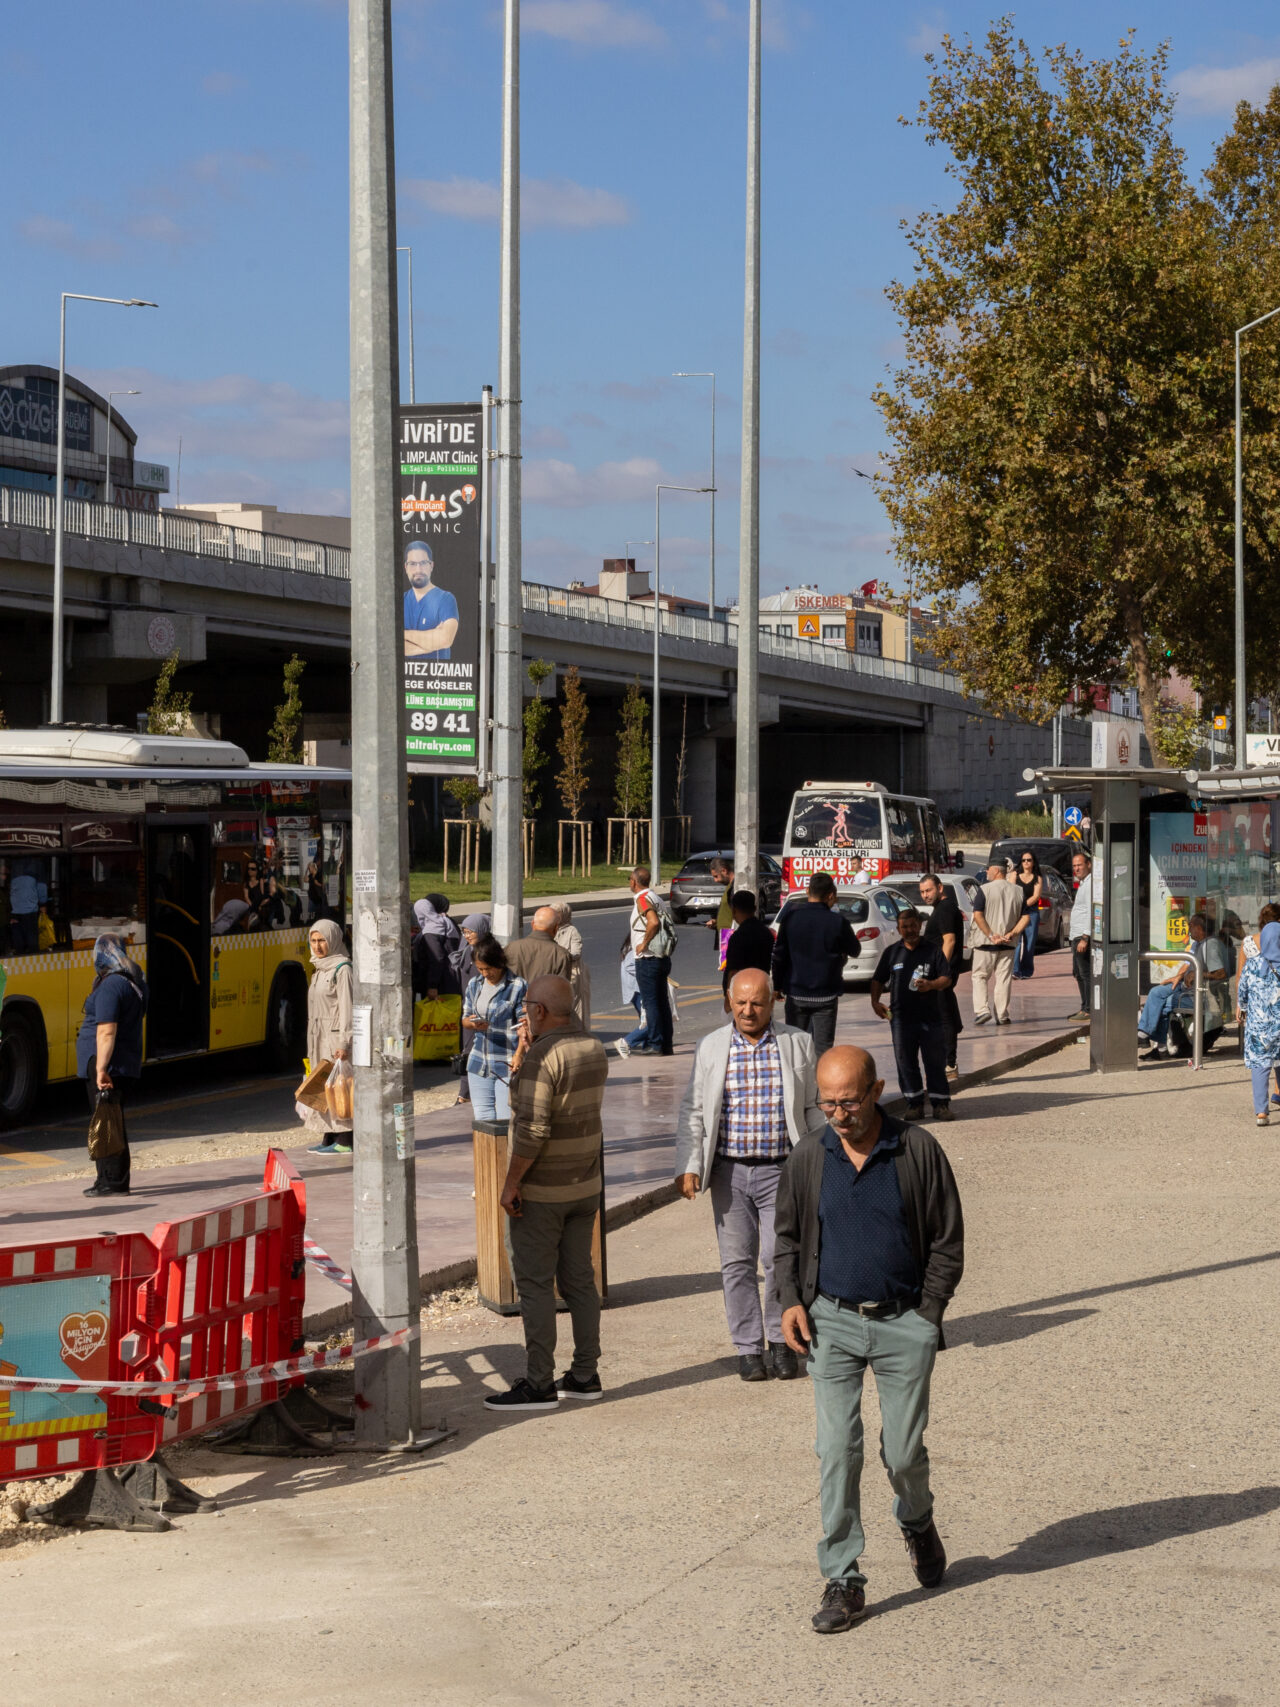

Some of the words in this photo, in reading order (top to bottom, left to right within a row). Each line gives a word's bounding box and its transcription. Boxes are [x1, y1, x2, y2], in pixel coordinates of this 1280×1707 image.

[400, 419, 475, 443] İVRİ’DE
[407, 451, 449, 463] IMPLANT
[451, 450, 478, 463] Clinic
[415, 501, 443, 511] Implant
[404, 522, 461, 533] CLINIC
[430, 663, 472, 677] UZMANI
[427, 679, 472, 691] KÖSELER
[406, 695, 424, 706] LÜNE
[410, 712, 438, 731] 89
[443, 713, 470, 732] 41
[406, 739, 471, 753] taltrakya.com
[793, 858, 834, 874] anpa
[837, 858, 879, 876] grss
[1169, 919, 1187, 927] ICE
[1169, 928, 1188, 936] TEA
[419, 1023, 458, 1032] ATLAS
[80, 1321, 88, 1329] 16
